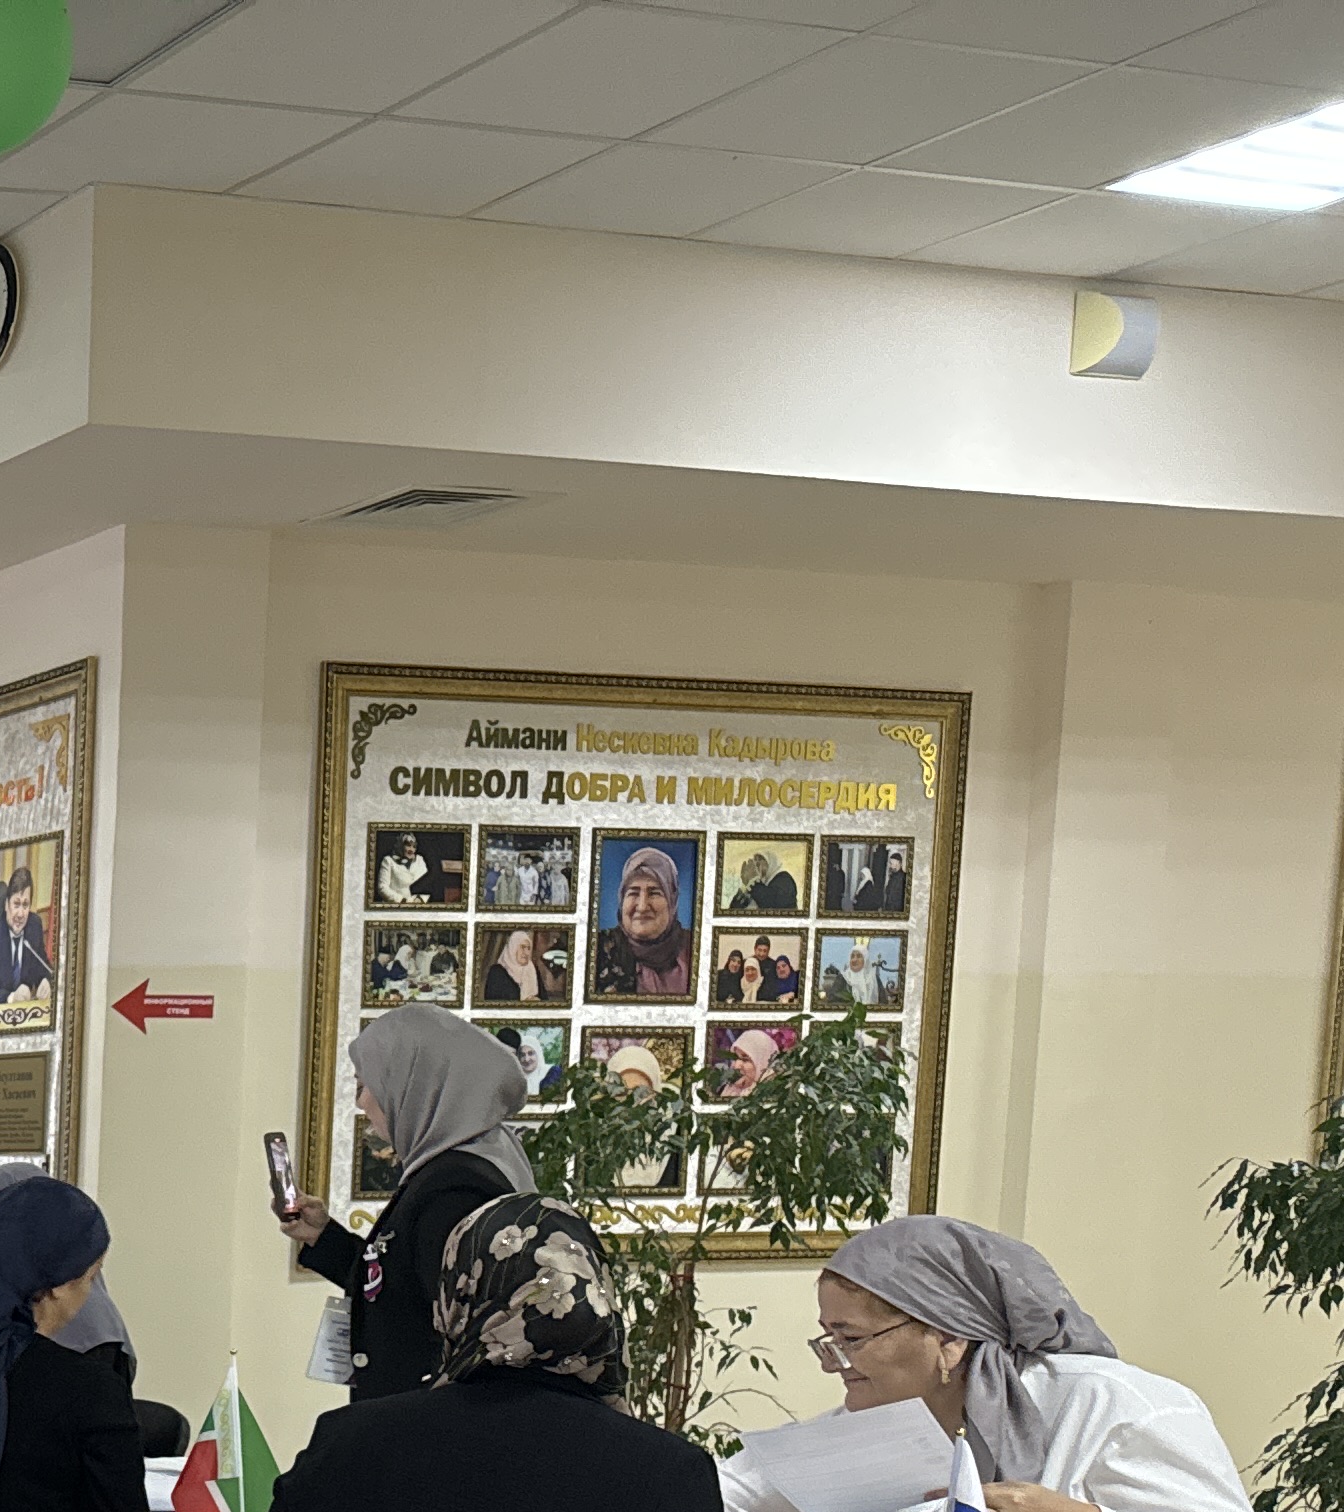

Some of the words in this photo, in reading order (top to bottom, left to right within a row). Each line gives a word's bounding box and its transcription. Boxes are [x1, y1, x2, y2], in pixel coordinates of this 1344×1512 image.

[465, 719, 567, 751] Аймани
[708, 727, 836, 766] Кадырова
[389, 766, 529, 799] СИМВОЛ
[541, 770, 647, 805] ДОБРА
[655, 775, 677, 805] И
[686, 776, 898, 814] МИЛОСЕРДИЯ
